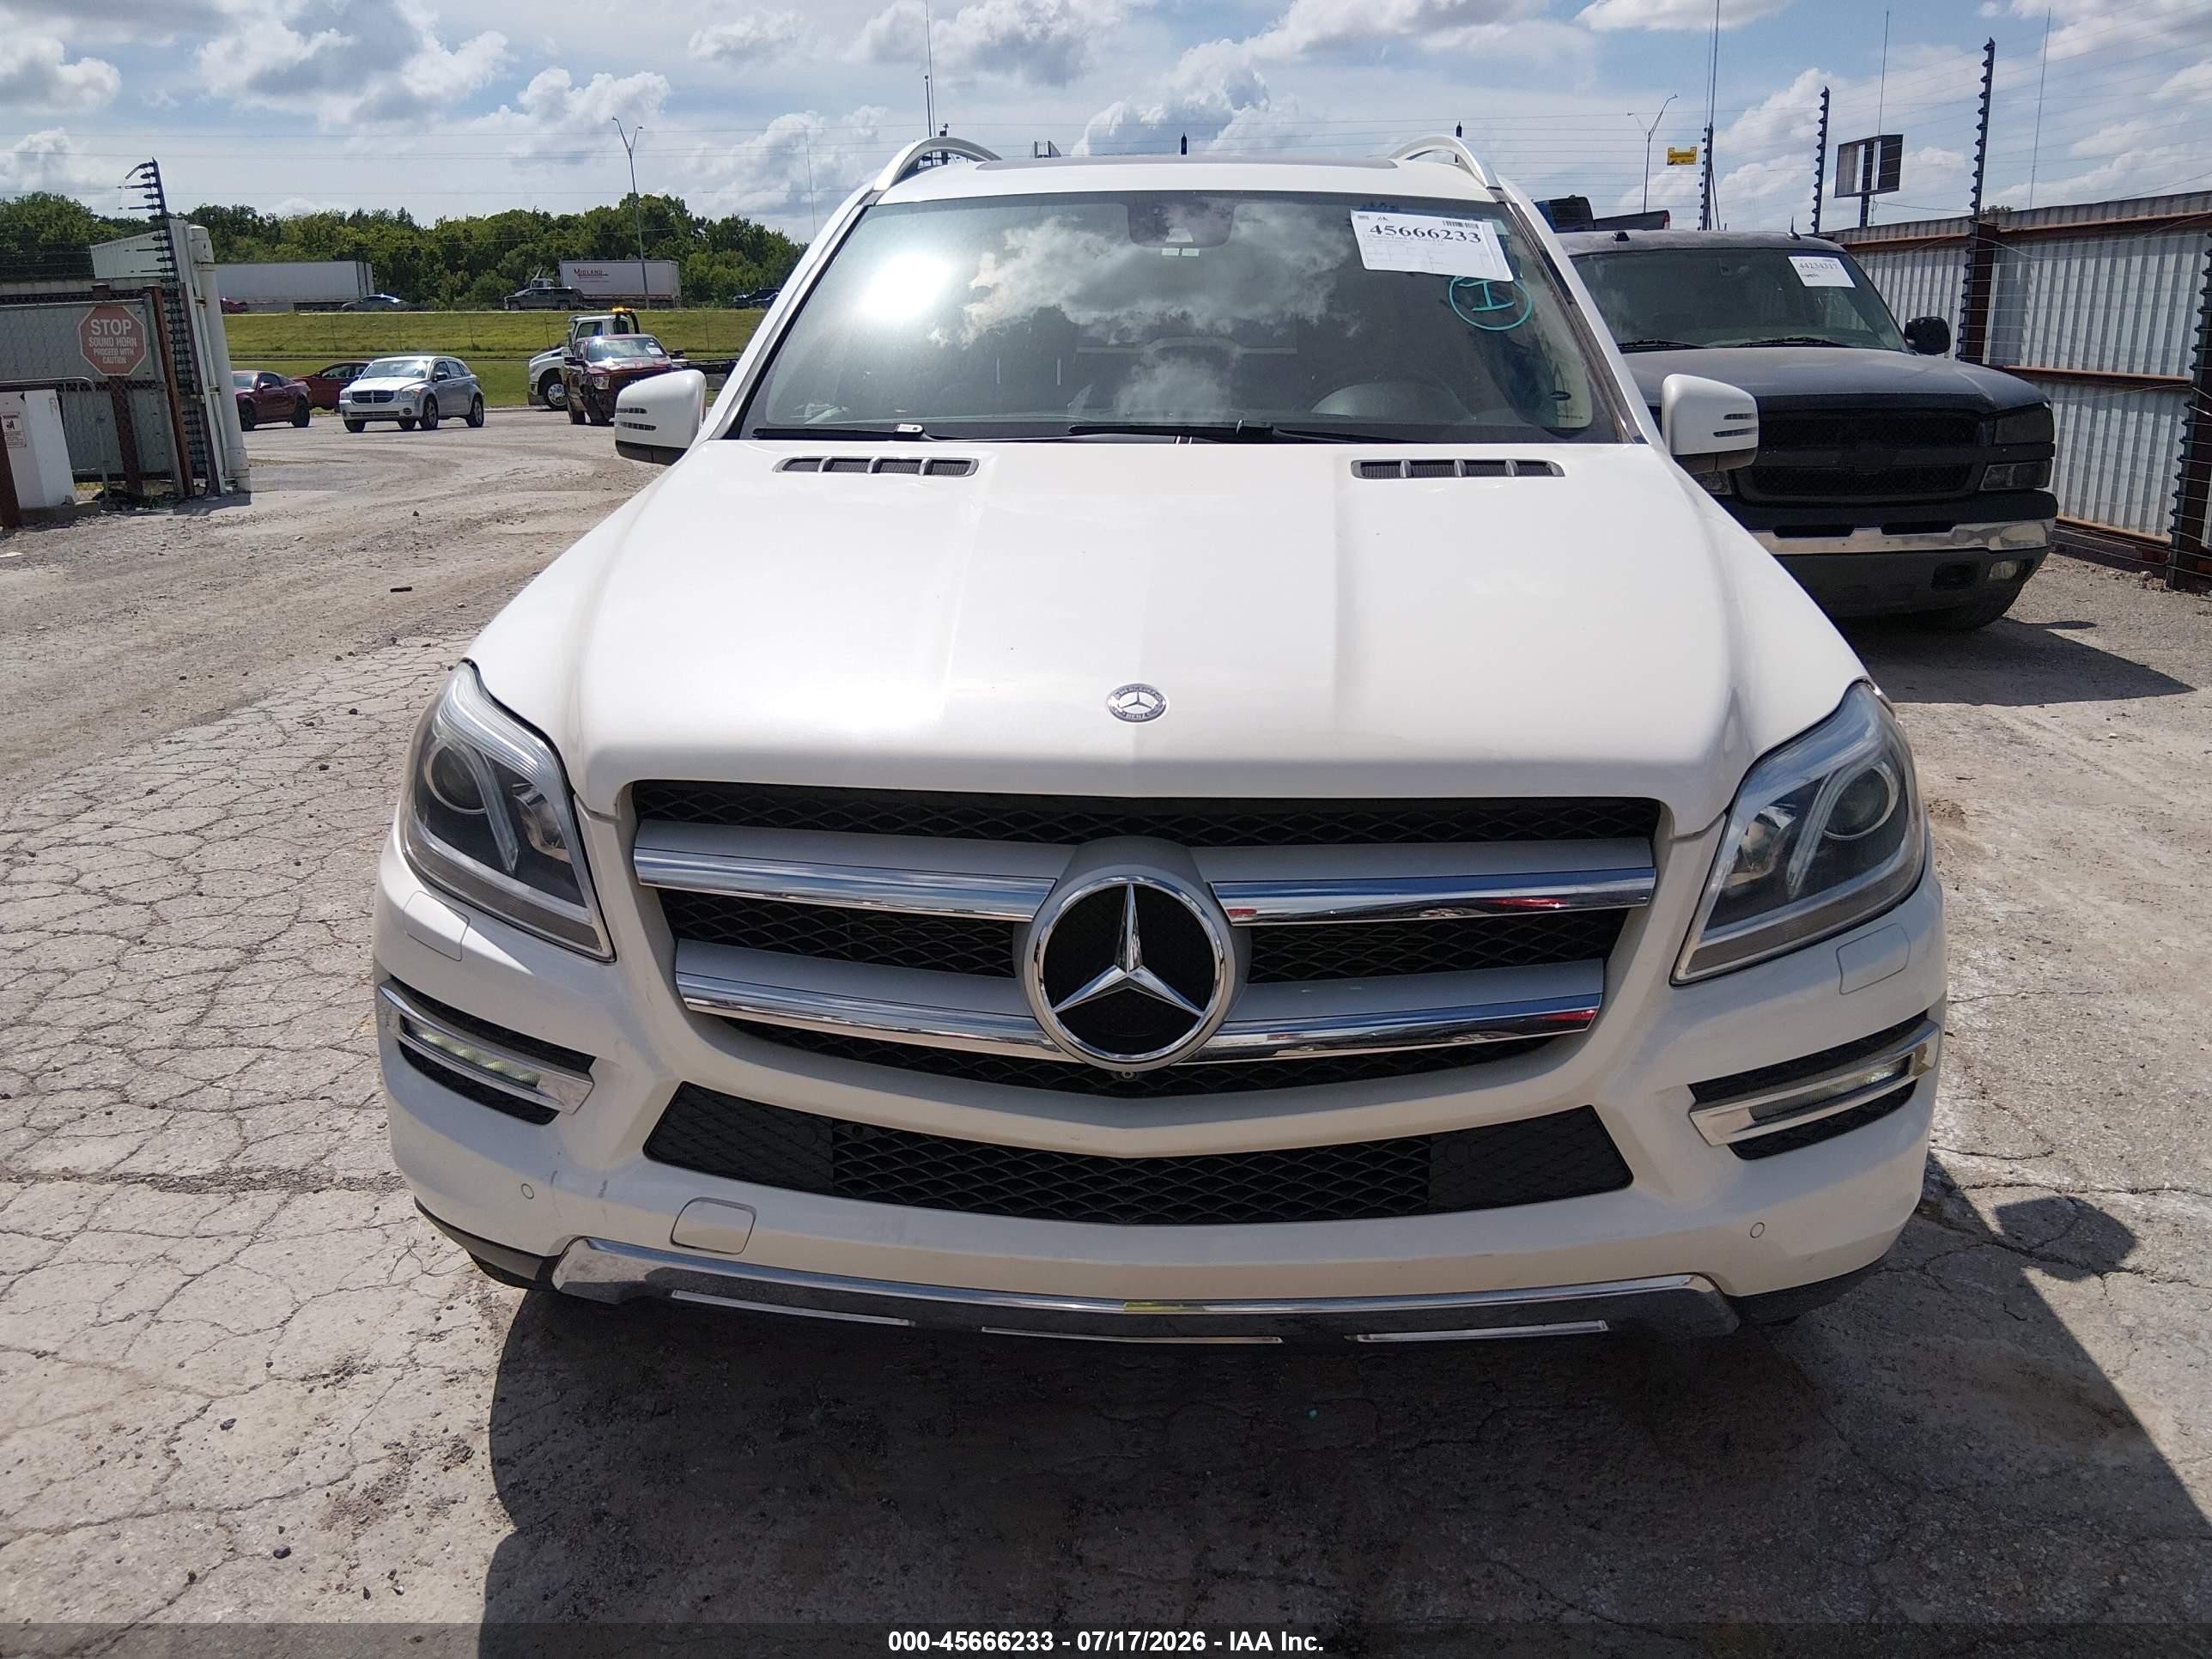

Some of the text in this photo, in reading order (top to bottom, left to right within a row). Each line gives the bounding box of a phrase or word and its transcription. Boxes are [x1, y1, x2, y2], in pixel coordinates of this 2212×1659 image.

[1369, 224, 1481, 244] 45666233
[574, 268, 604, 276] MIDLAND
[90, 319, 132, 336] STOP
[88, 337, 137, 348] SOUND HORN
[119, 348, 135, 356] WITH
